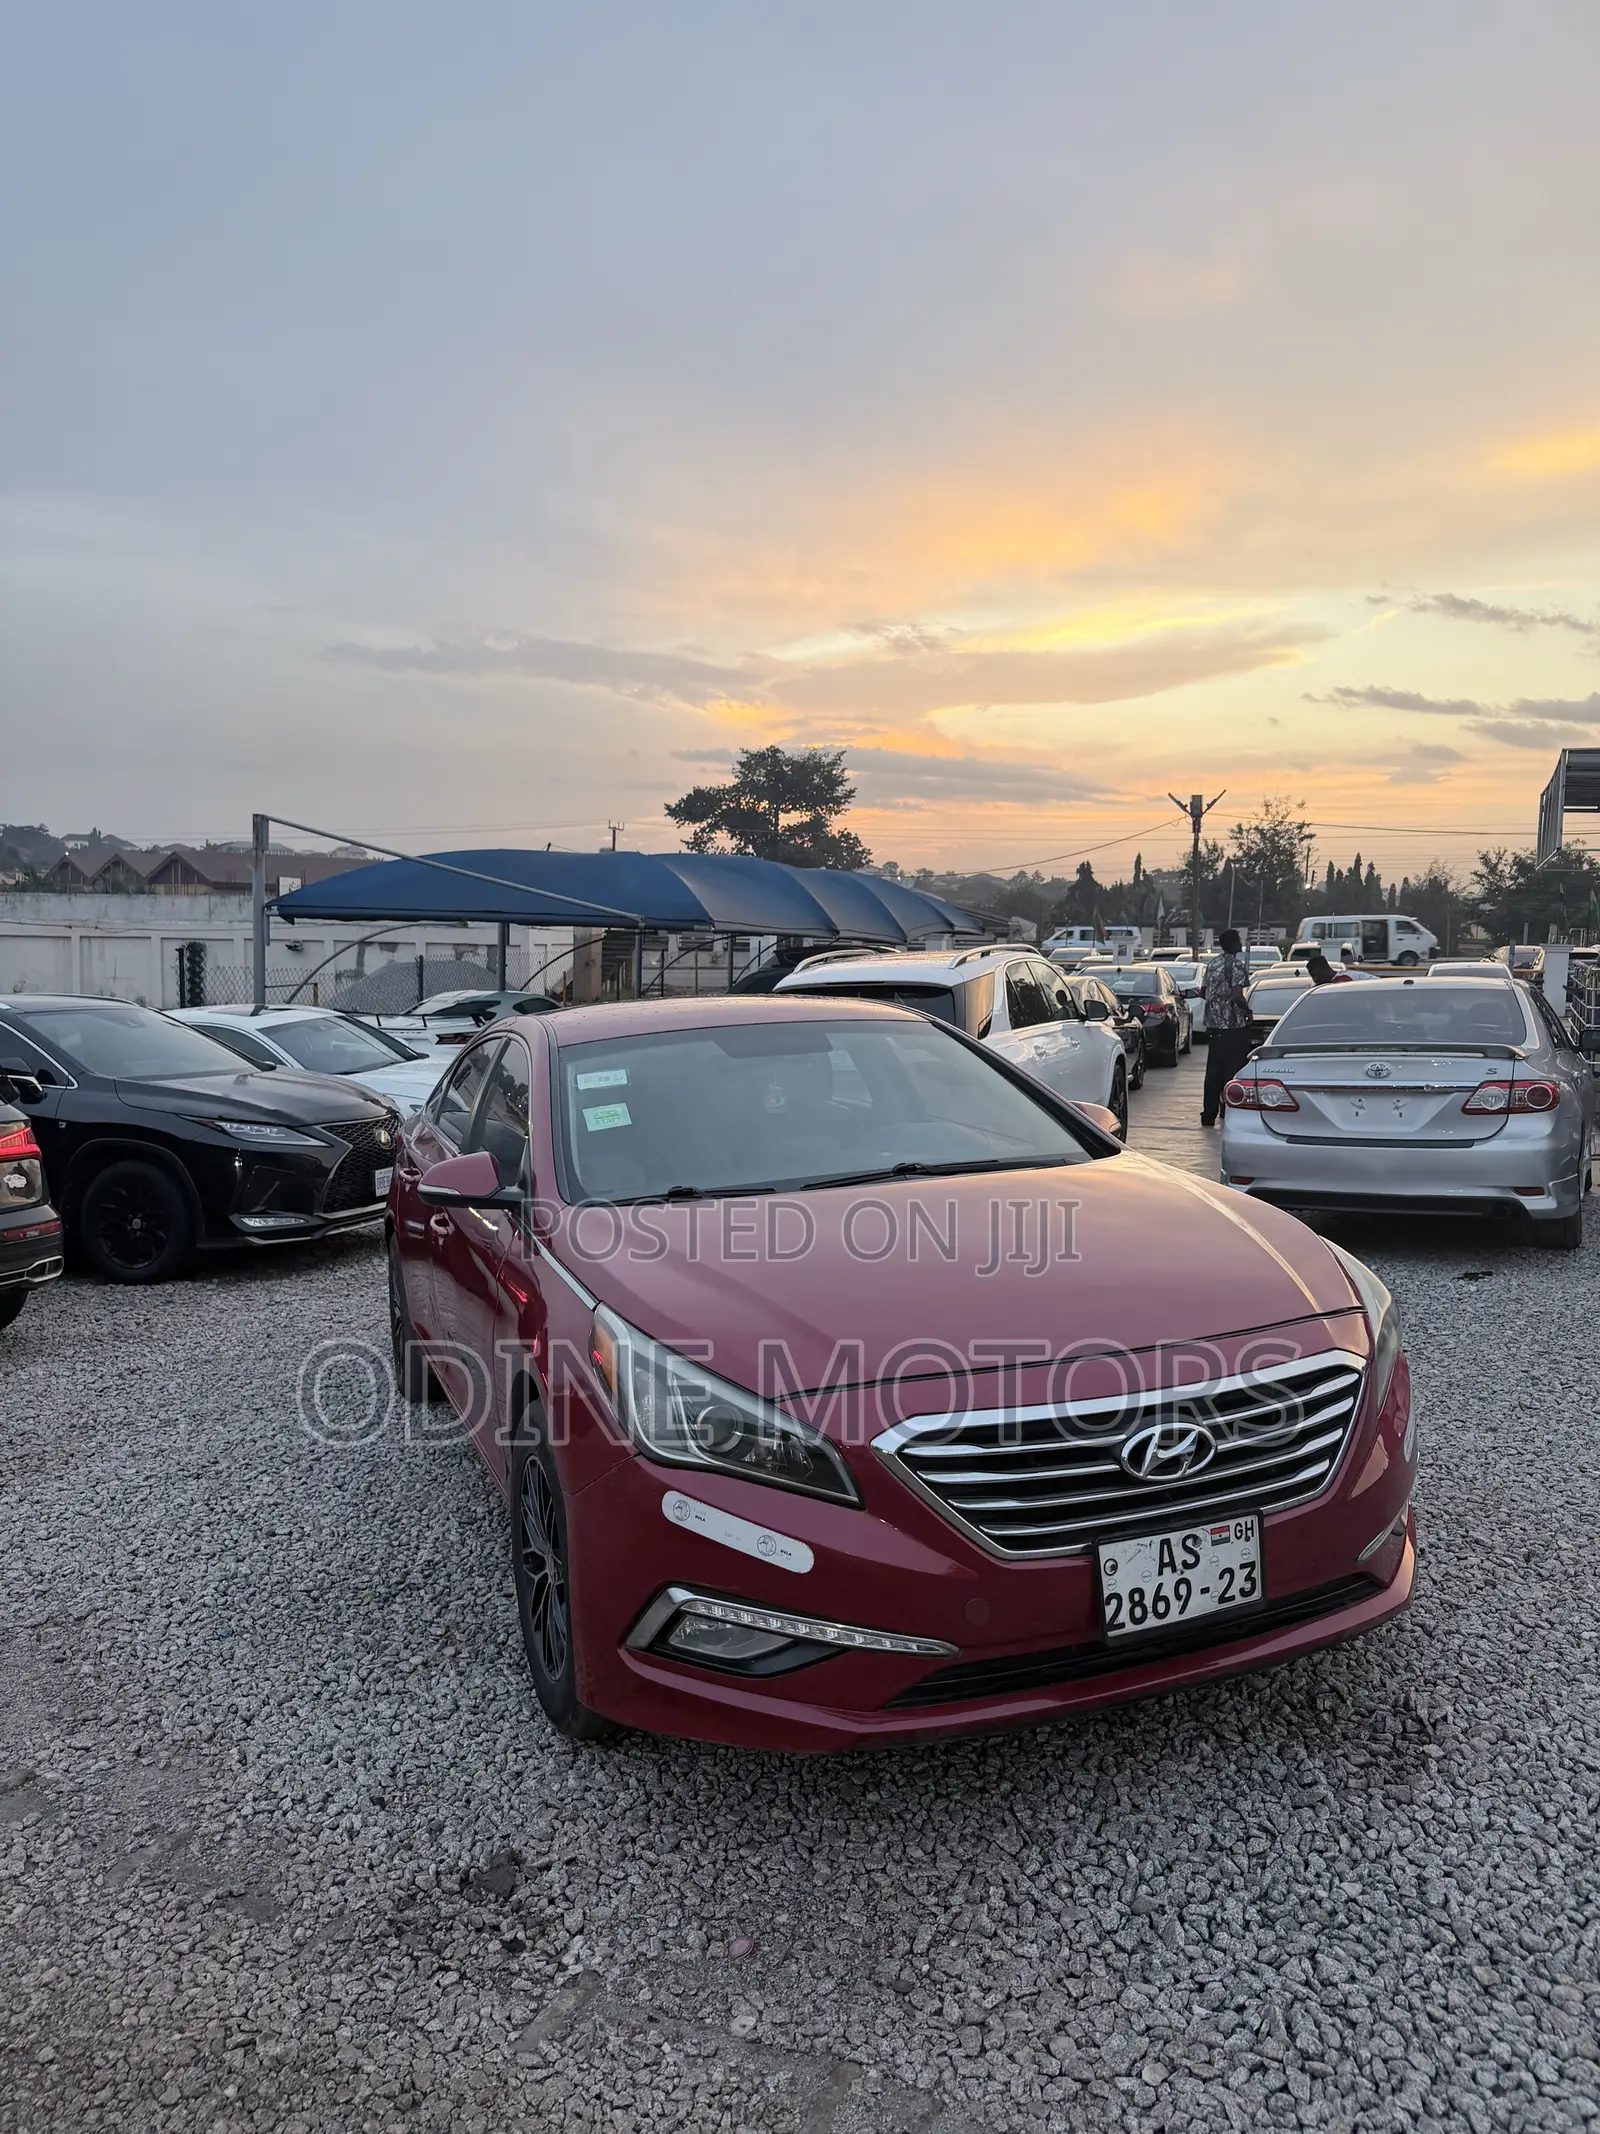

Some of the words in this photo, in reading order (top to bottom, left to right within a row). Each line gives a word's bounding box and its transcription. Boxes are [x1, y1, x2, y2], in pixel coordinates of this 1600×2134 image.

[1234, 1519, 1255, 1542] GH
[1157, 1533, 1201, 1577] AS
[1104, 1561, 1256, 1631] 2869-23
